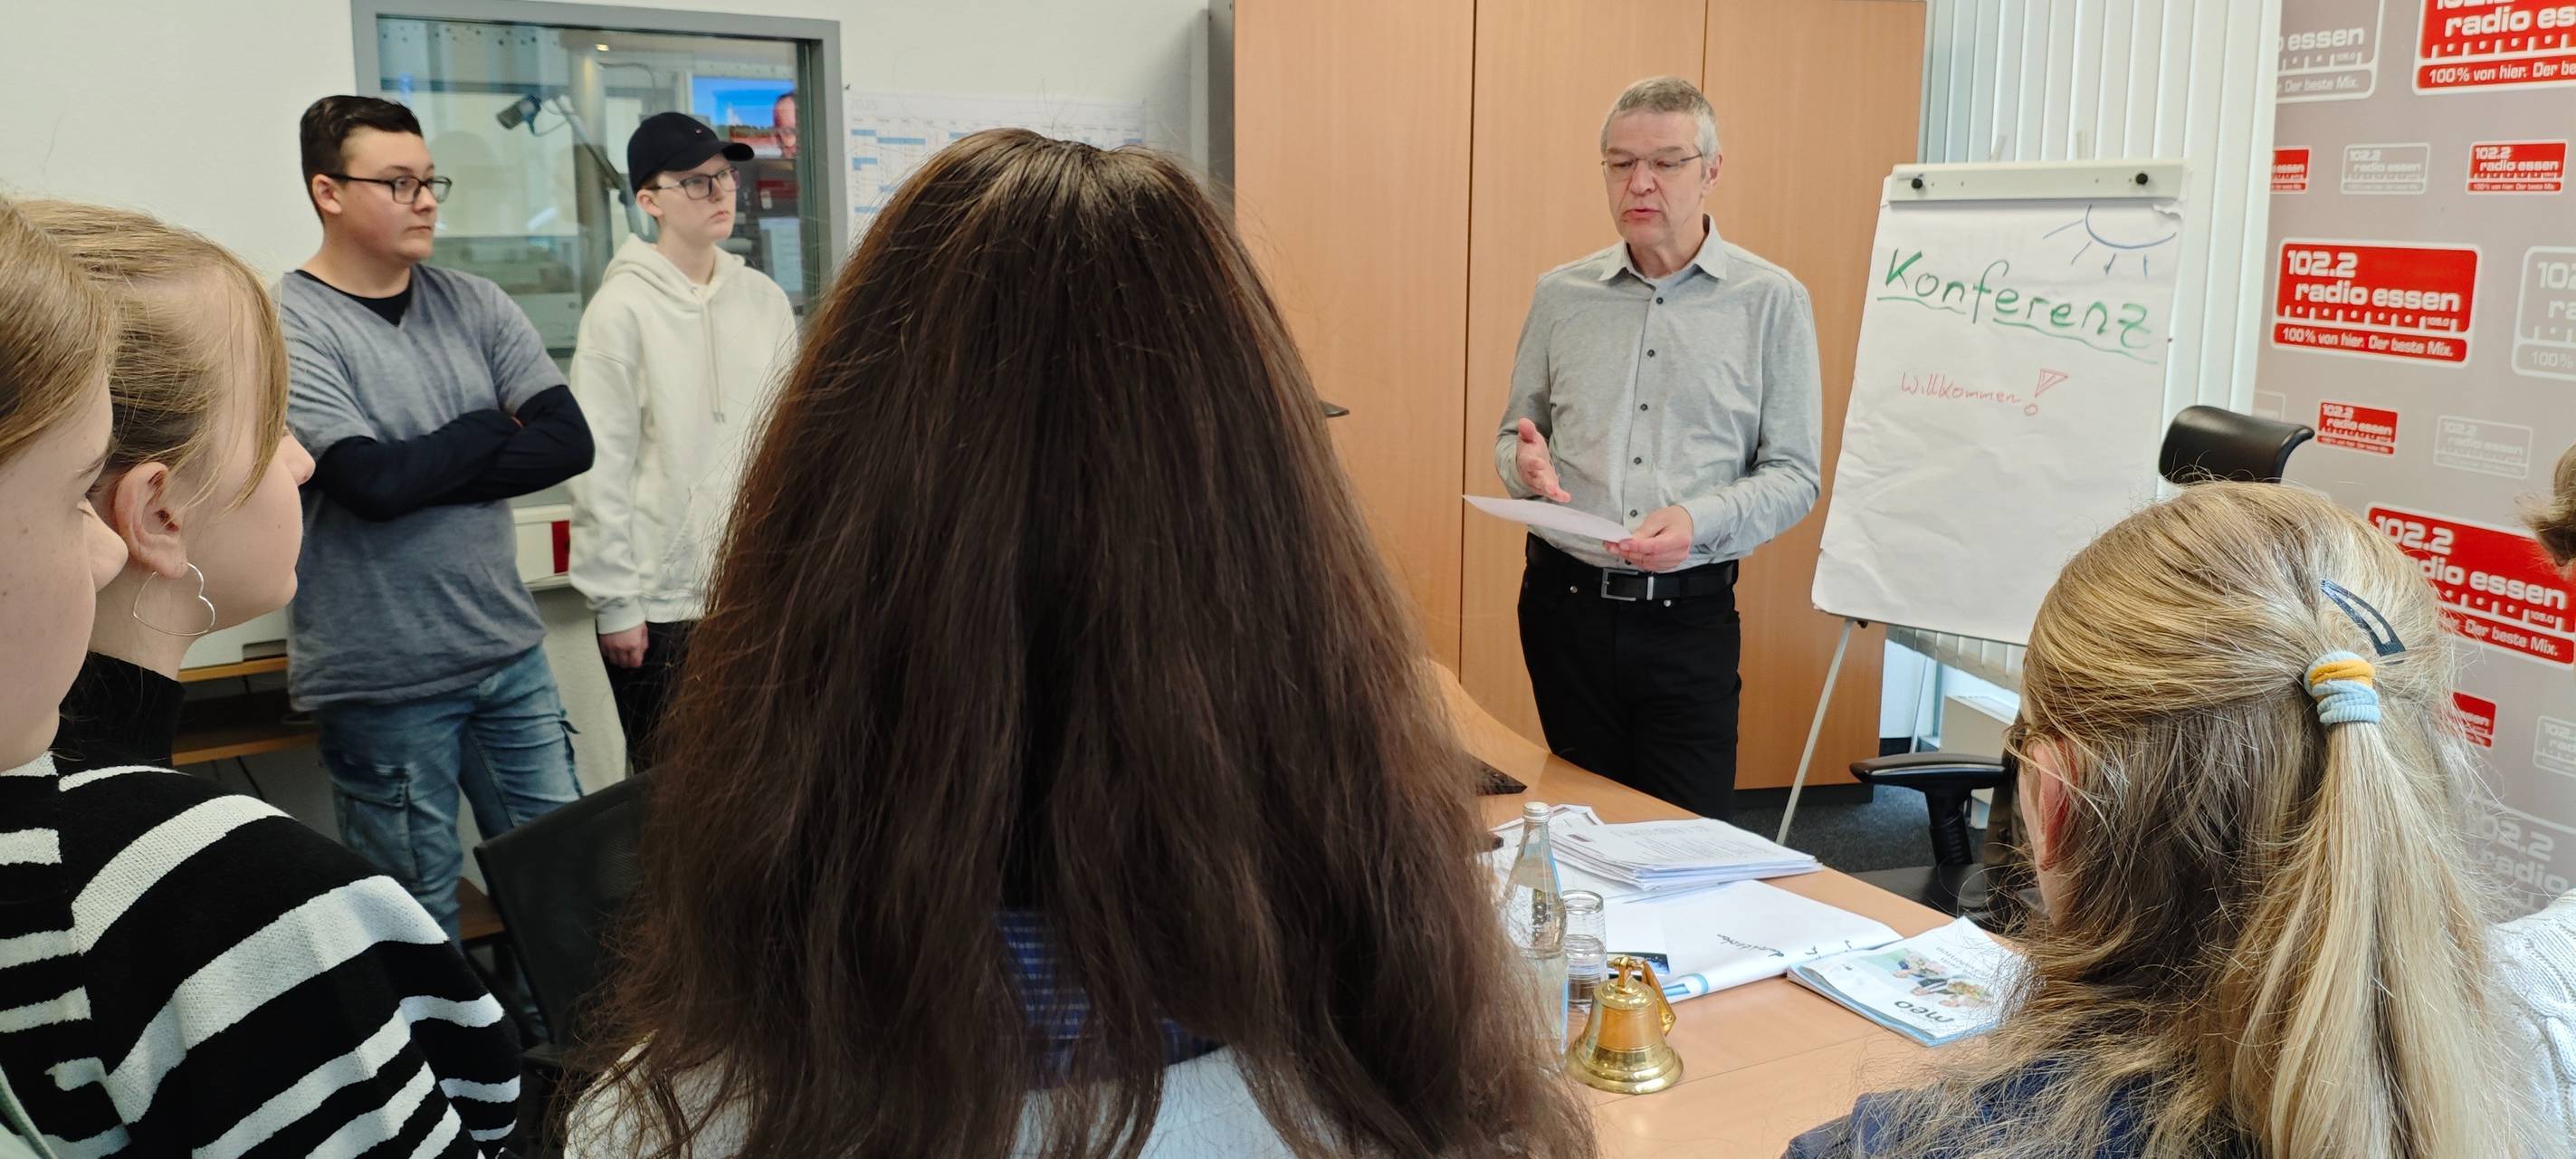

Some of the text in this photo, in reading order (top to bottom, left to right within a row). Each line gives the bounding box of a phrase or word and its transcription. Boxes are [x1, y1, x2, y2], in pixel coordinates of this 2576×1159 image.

[2445, 6, 2531, 37] radio
[2287, 28, 2364, 51] essen
[2429, 67, 2469, 83] 100%
[2474, 69, 2495, 81] von
[2499, 64, 2527, 80] hier.
[2533, 62, 2558, 78] Der
[2476, 146, 2512, 160] 102.2
[2479, 159, 2559, 172] radio essen
[2353, 161, 2386, 173] radio
[2287, 249, 2358, 278] 102.2
[1884, 247, 2152, 350] Konferenz
[2295, 280, 2461, 312] radio essen
[2283, 327, 2316, 343] 100%
[2318, 332, 2339, 346] von
[2368, 334, 2390, 350] Der
[2390, 338, 2425, 354] beste
[2326, 417, 2393, 436] radio essen
[2375, 515, 2455, 556] 102.2
[2468, 570, 2567, 610] essen
[2465, 618, 2489, 637] Der
[2491, 626, 2528, 648] beste
[2530, 637, 2559, 656] Mix.
[1894, 1000, 1954, 1024] meo
